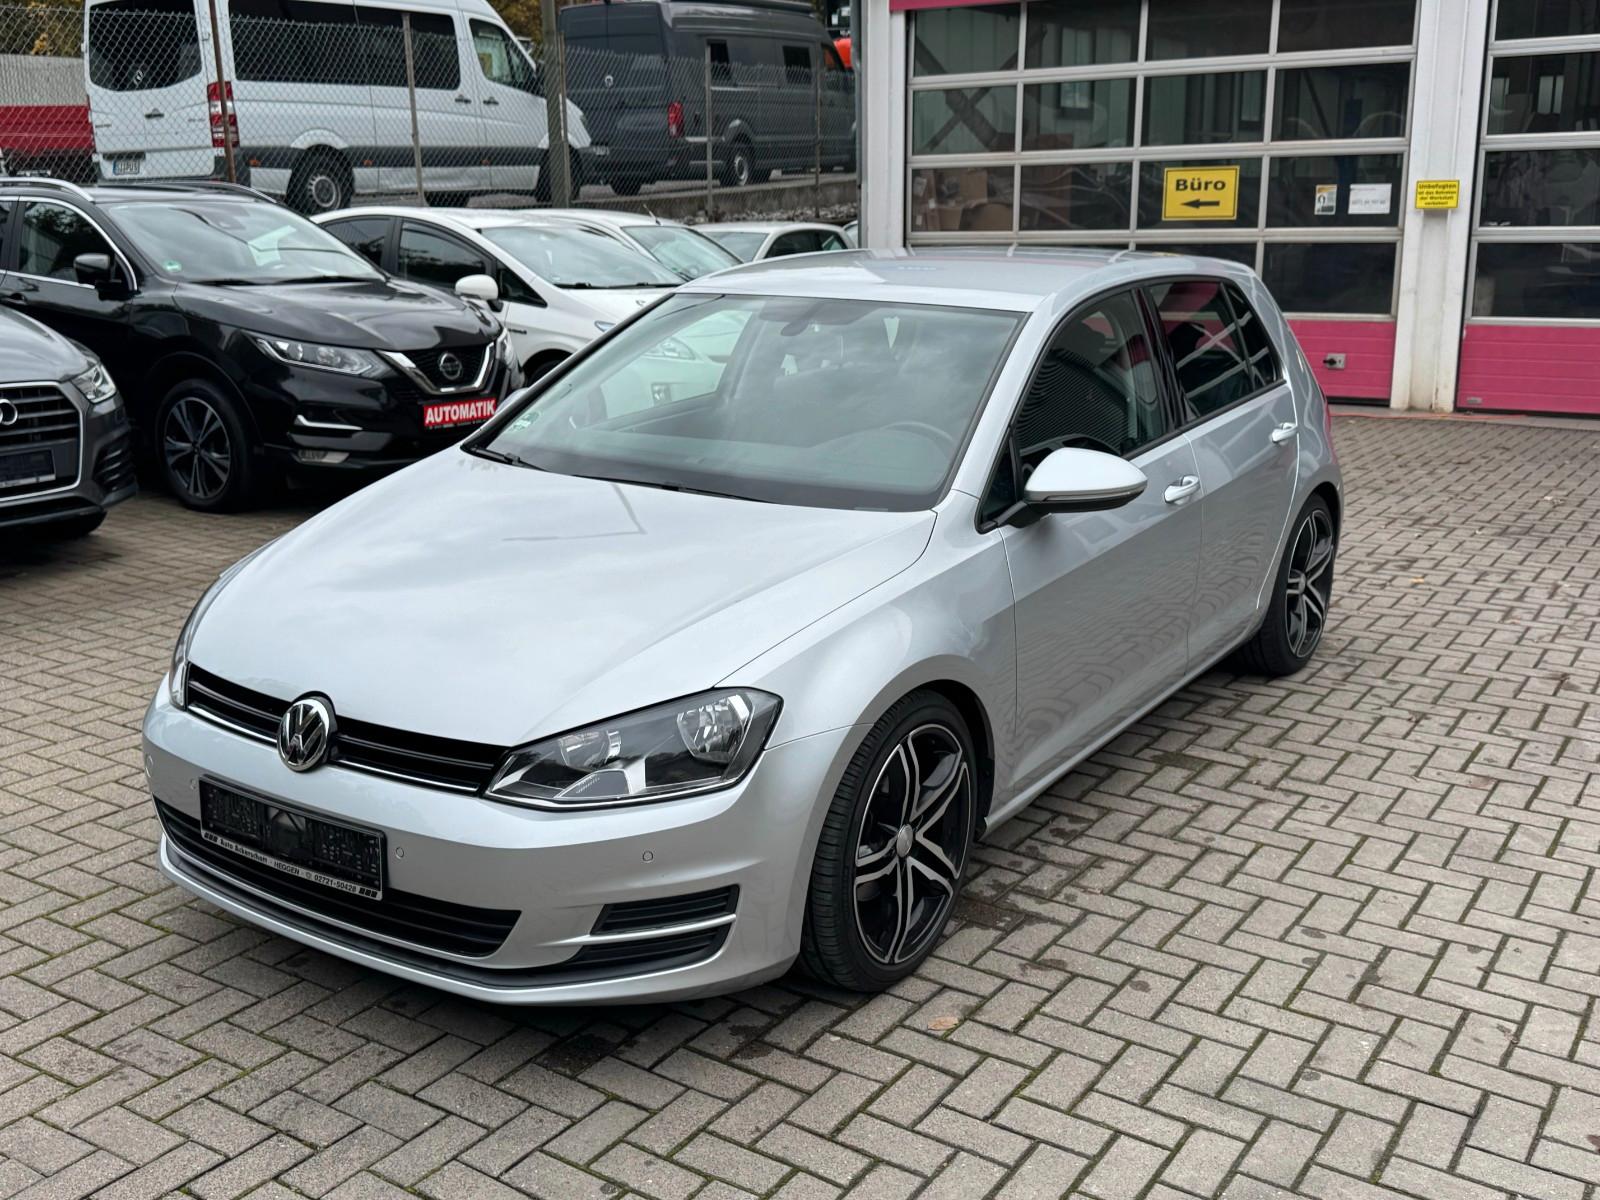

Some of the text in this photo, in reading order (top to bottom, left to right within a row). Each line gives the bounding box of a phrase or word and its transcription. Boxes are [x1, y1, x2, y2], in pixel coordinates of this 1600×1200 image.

[1175, 178, 1226, 191] Büro
[425, 400, 496, 424] AUTOMATIK
[220, 838, 234, 849] Auto
